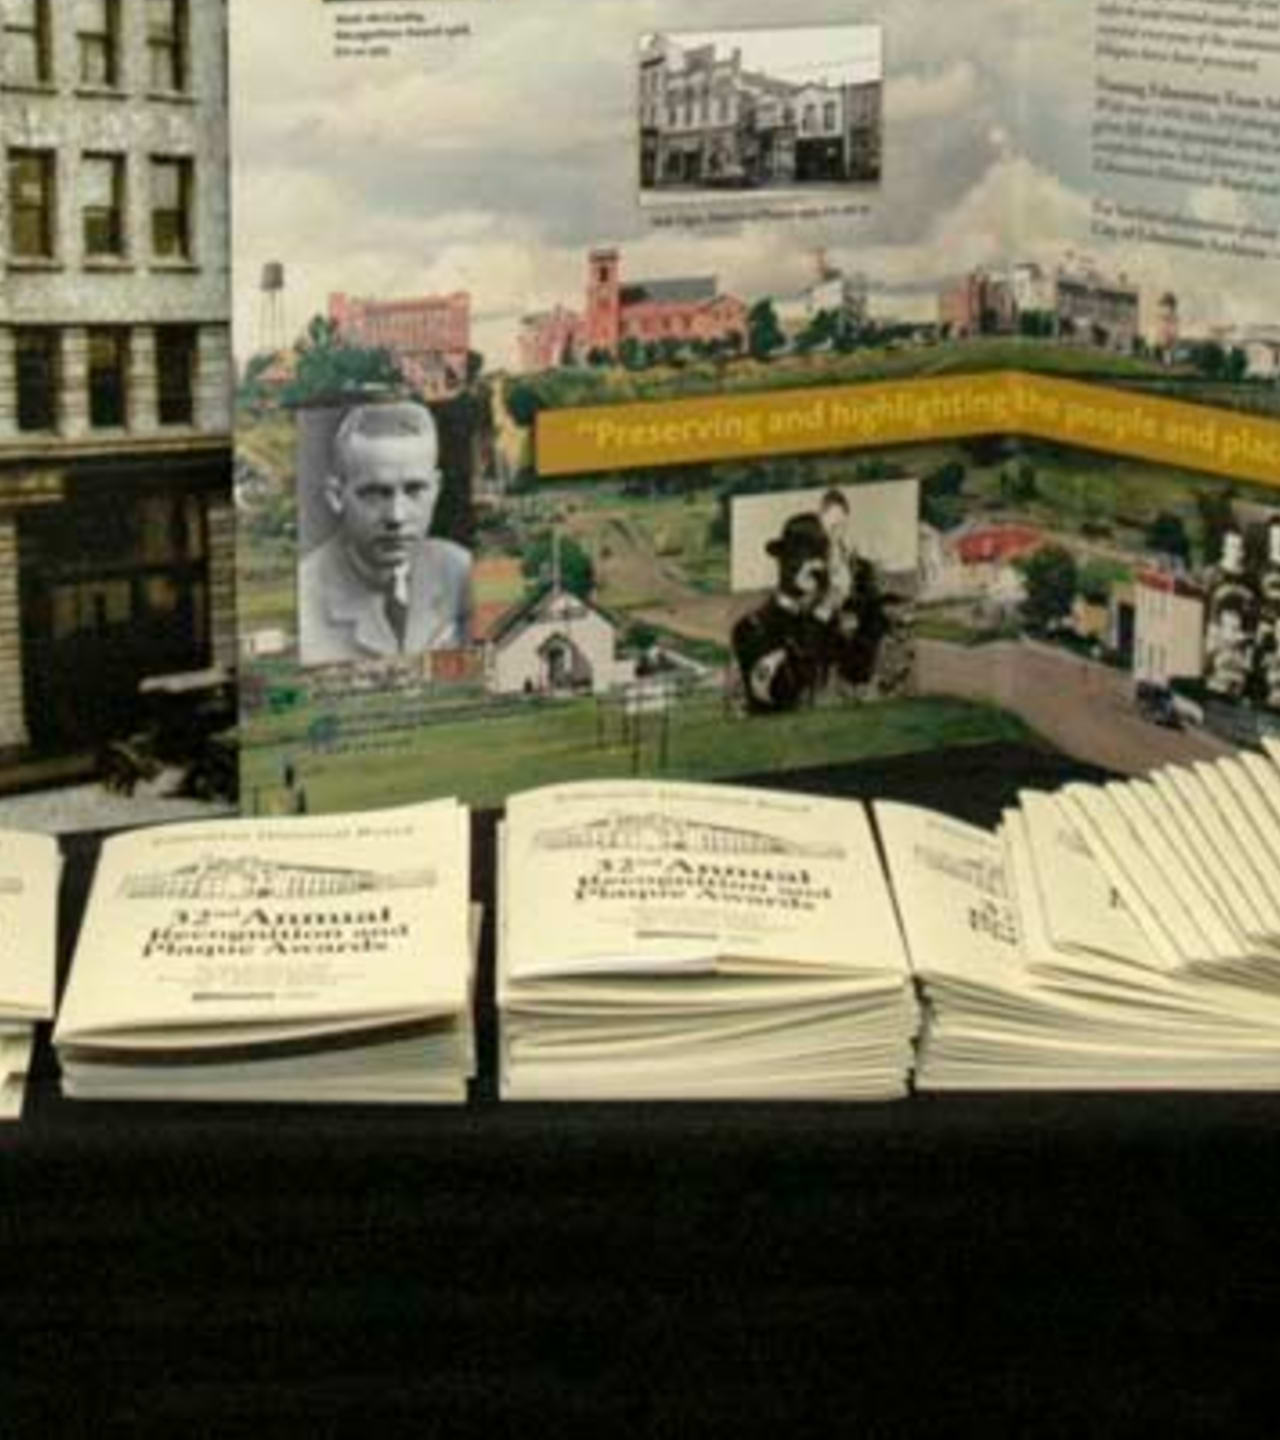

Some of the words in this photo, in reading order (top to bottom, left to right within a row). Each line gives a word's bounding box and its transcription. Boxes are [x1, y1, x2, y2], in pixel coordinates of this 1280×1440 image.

[768, 401, 821, 435] and
[829, 388, 1005, 436] highlighting
[1016, 386, 1060, 421] the
[1065, 401, 1158, 440] people
[1164, 412, 1216, 448] and
[664, 858, 812, 886] Annual
[240, 905, 391, 927] Annual
[149, 925, 343, 944] Recognition
[352, 922, 410, 940] and
[141, 942, 255, 959] Plaque
[263, 938, 388, 957] Awards
